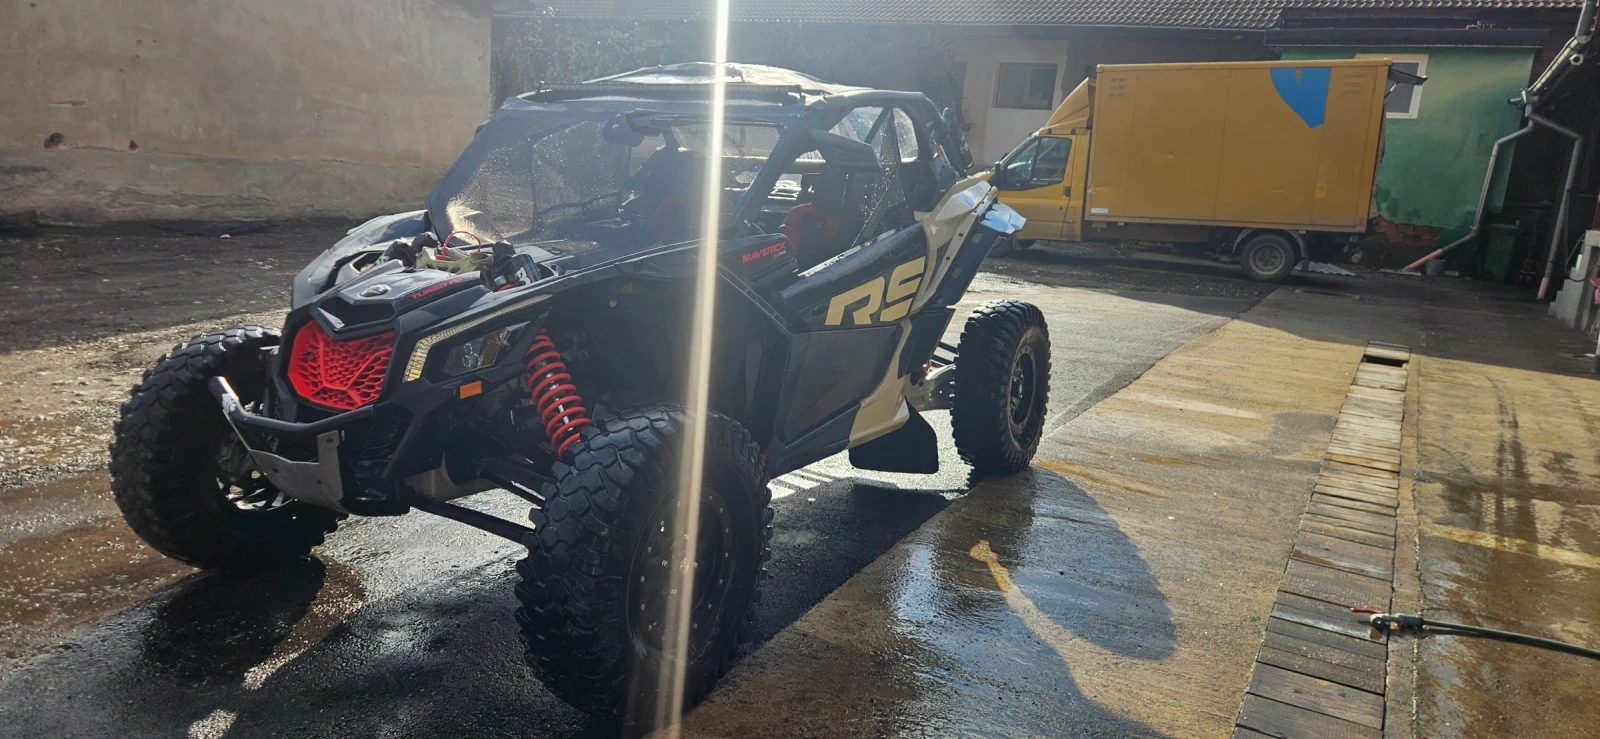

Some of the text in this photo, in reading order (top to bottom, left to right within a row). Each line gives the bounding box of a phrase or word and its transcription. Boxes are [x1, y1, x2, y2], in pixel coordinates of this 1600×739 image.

[742, 241, 786, 263] MAVERICK
[411, 282, 448, 298] TURBO
[824, 256, 926, 325] RS
